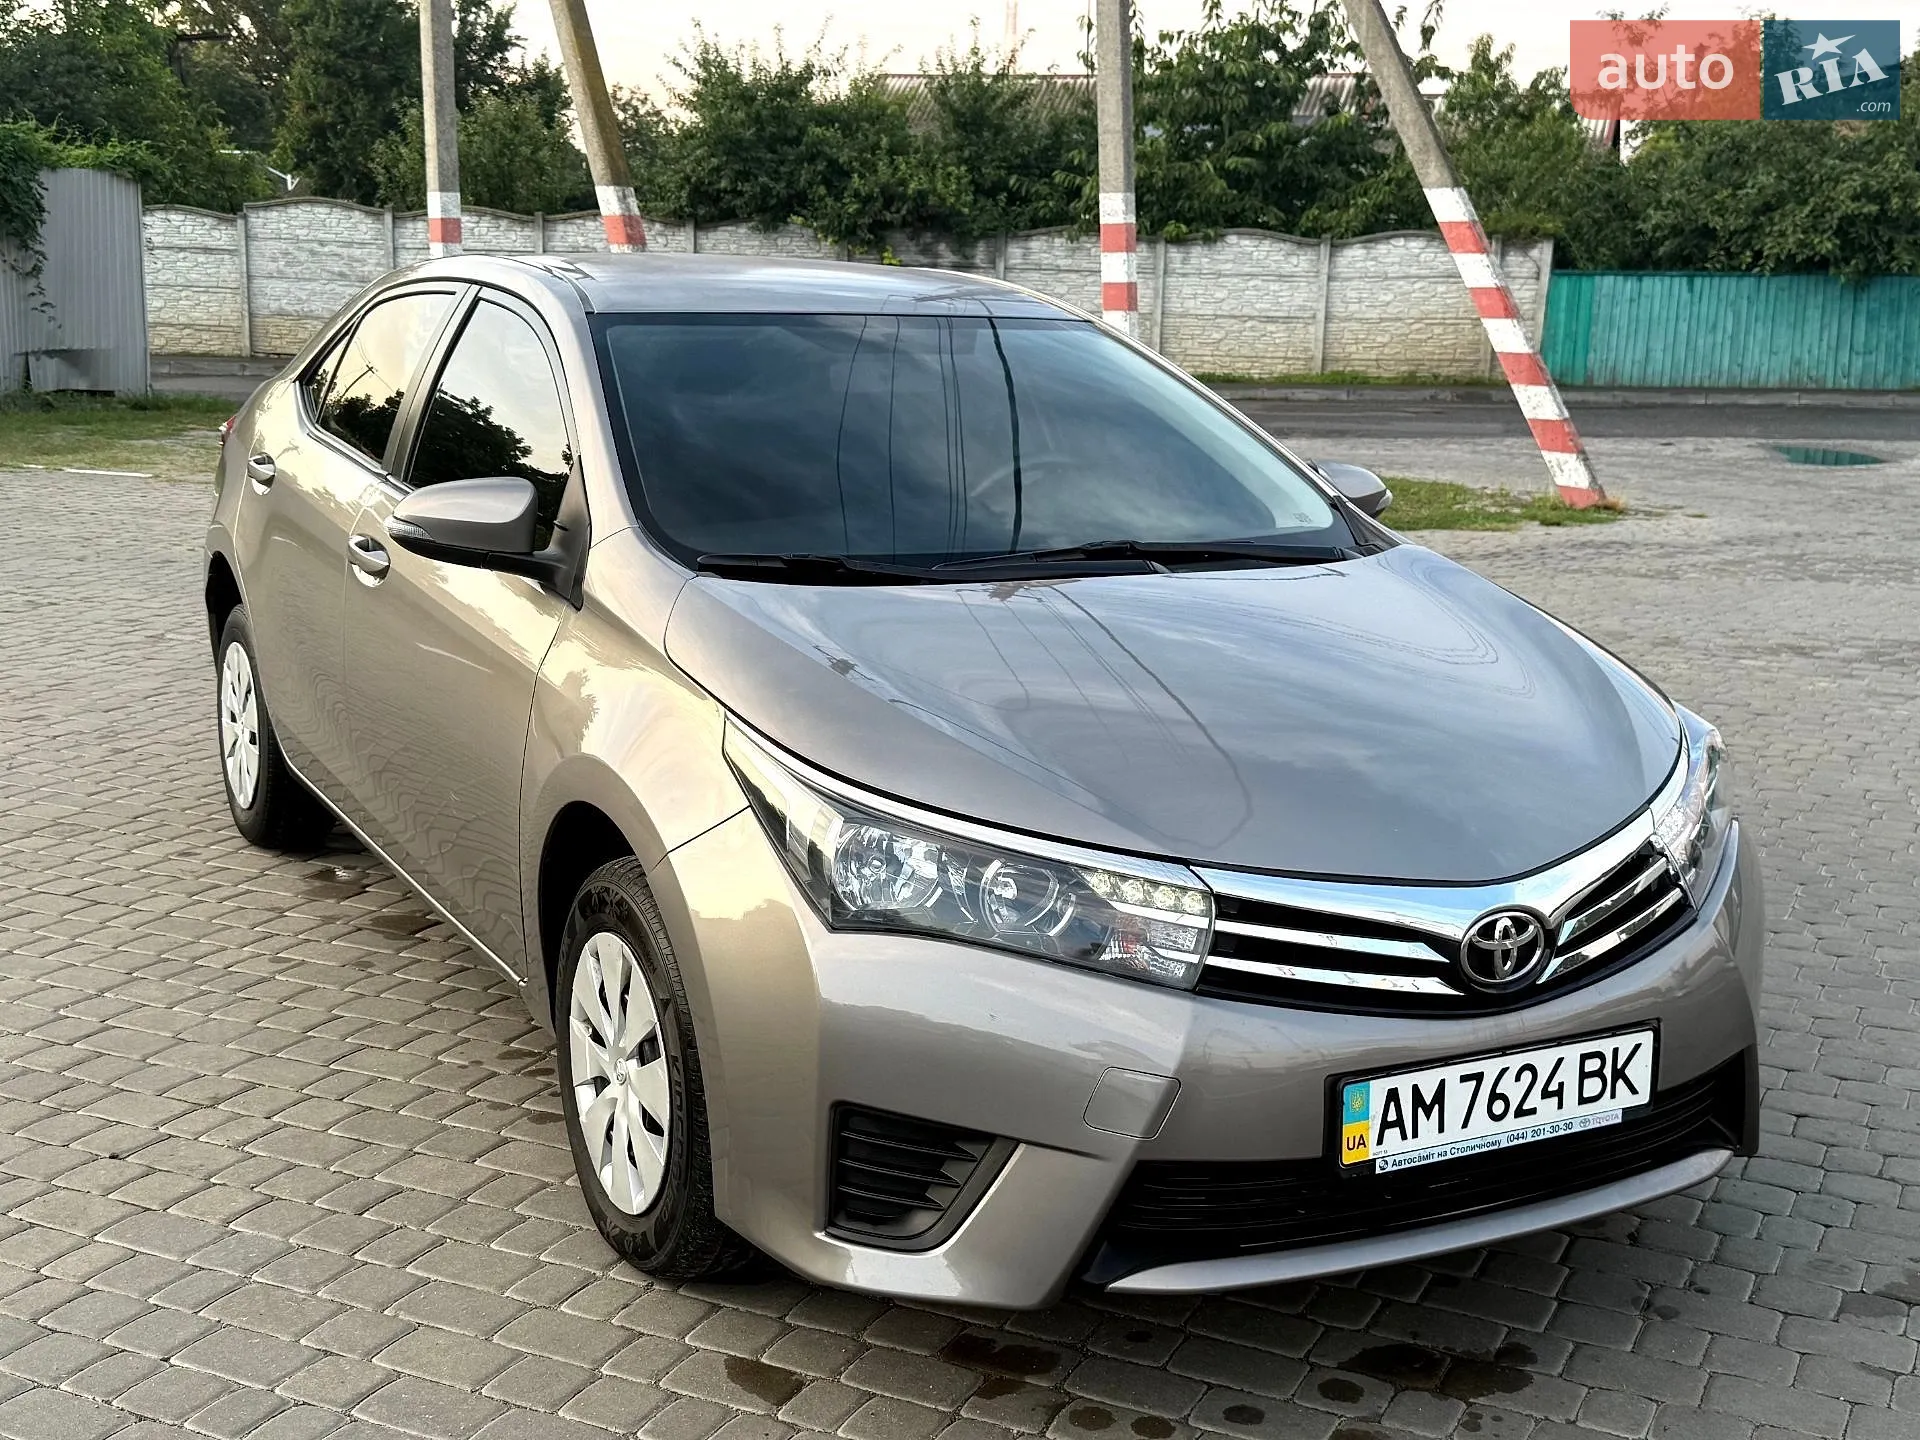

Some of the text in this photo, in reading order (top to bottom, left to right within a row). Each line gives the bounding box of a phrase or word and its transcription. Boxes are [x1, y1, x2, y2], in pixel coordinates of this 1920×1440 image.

[1376, 1042, 1642, 1146] AM 7624 BK
[1346, 1134, 1367, 1151] UA
[1437, 1150, 1448, 1158] на
[1450, 1139, 1502, 1156] Столичному
[1506, 1131, 1528, 1144] (044)
[1531, 1121, 1574, 1138] 201-30-30
[1591, 1113, 1620, 1125] TOYOTA
